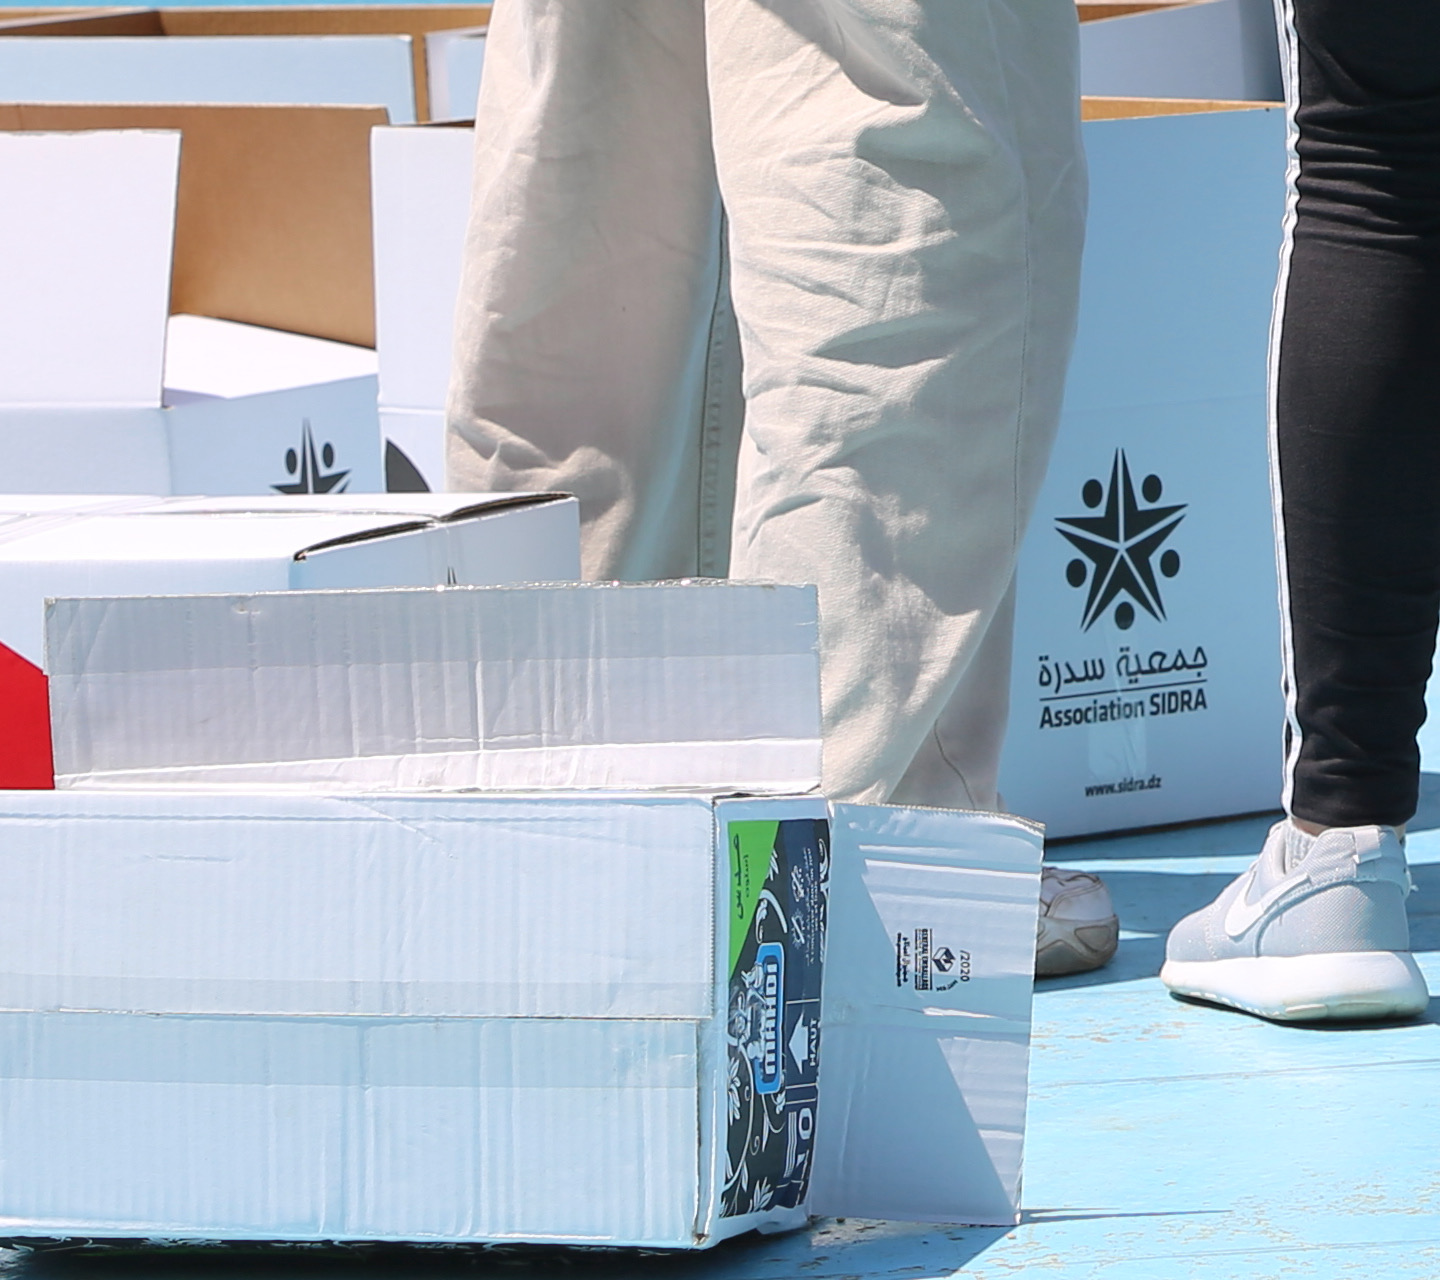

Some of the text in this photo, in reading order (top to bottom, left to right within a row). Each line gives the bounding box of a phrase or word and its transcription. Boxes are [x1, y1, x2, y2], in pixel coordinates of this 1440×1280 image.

[1038, 645, 1209, 694] جمعية سدرة
[1039, 687, 1208, 729] Association SIDRA
[1084, 773, 1163, 798] www.sidra.dz
[764, 962, 777, 1075] MAHDI
[809, 1018, 818, 1067] HAUT
